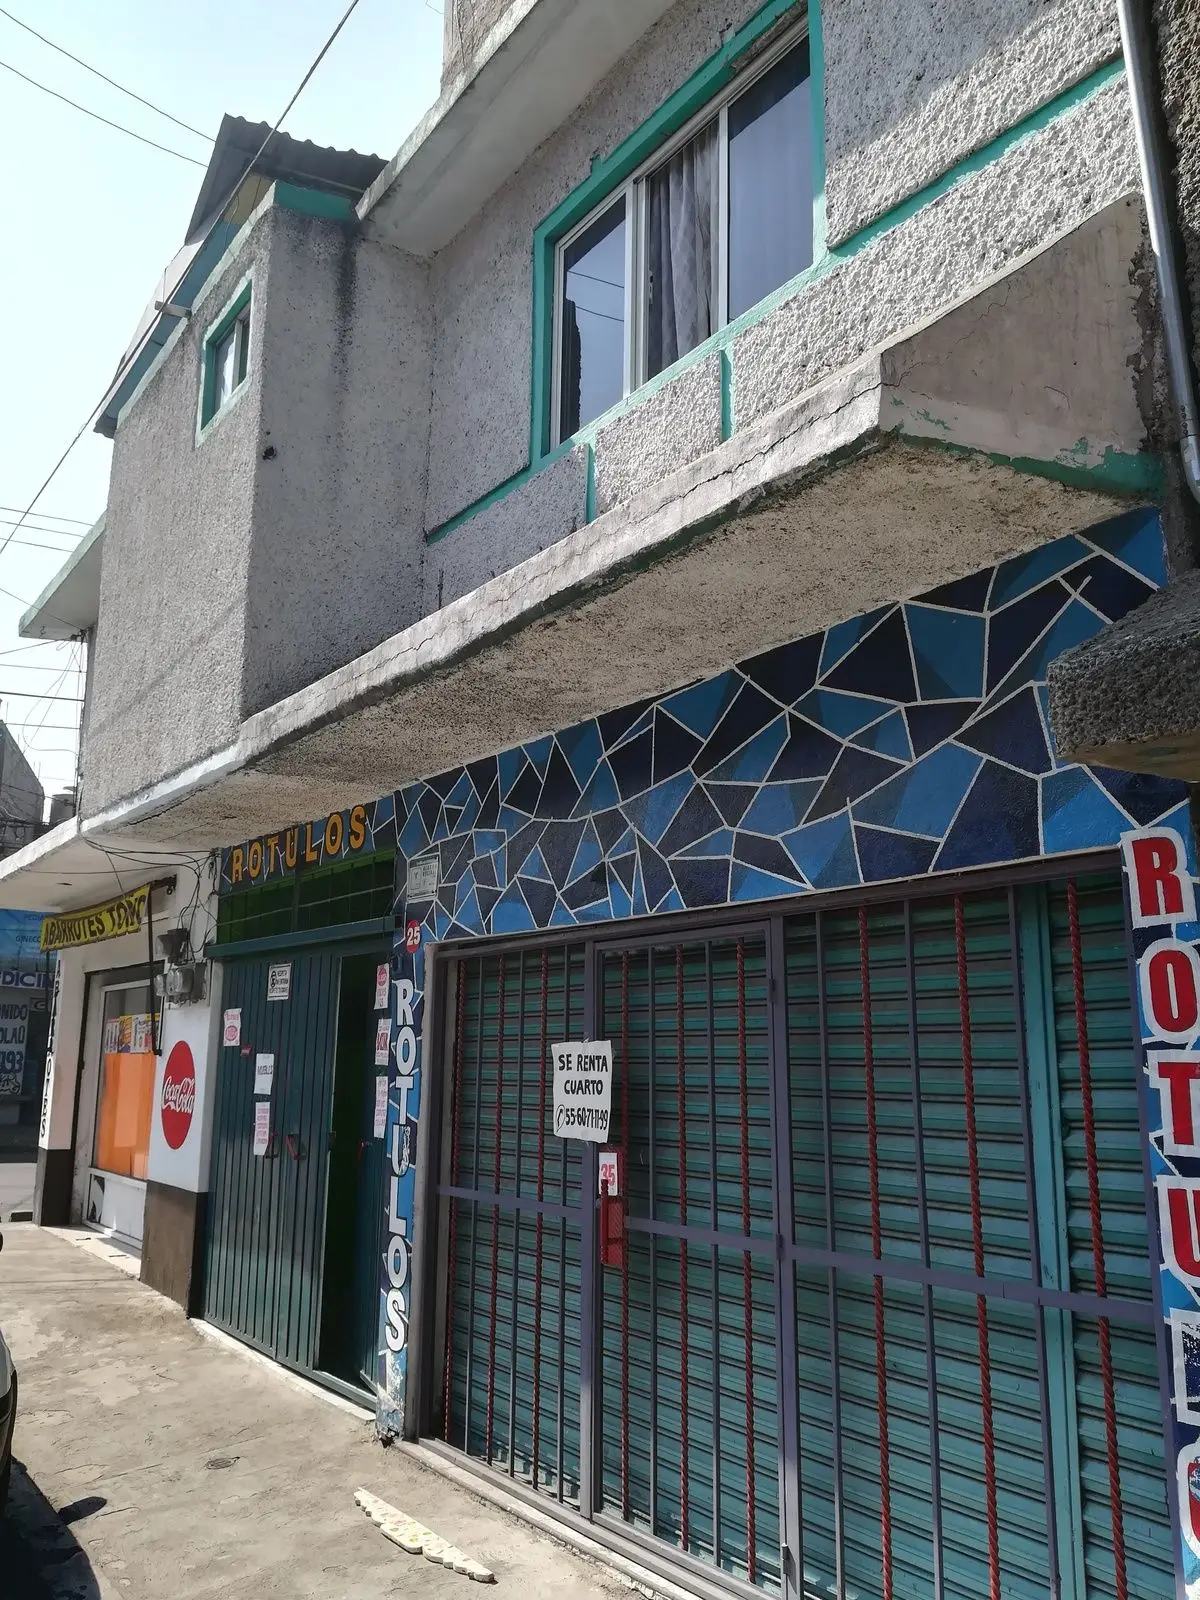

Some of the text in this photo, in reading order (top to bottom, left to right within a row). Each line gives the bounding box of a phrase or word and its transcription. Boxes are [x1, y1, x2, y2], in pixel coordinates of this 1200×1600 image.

[230, 804, 367, 884] ROTULOS
[406, 926, 421, 946] 25
[558, 1053, 608, 1072] SE RENTA
[564, 1079, 603, 1095] CUARTO
[386, 977, 417, 1352] ROTULOS
